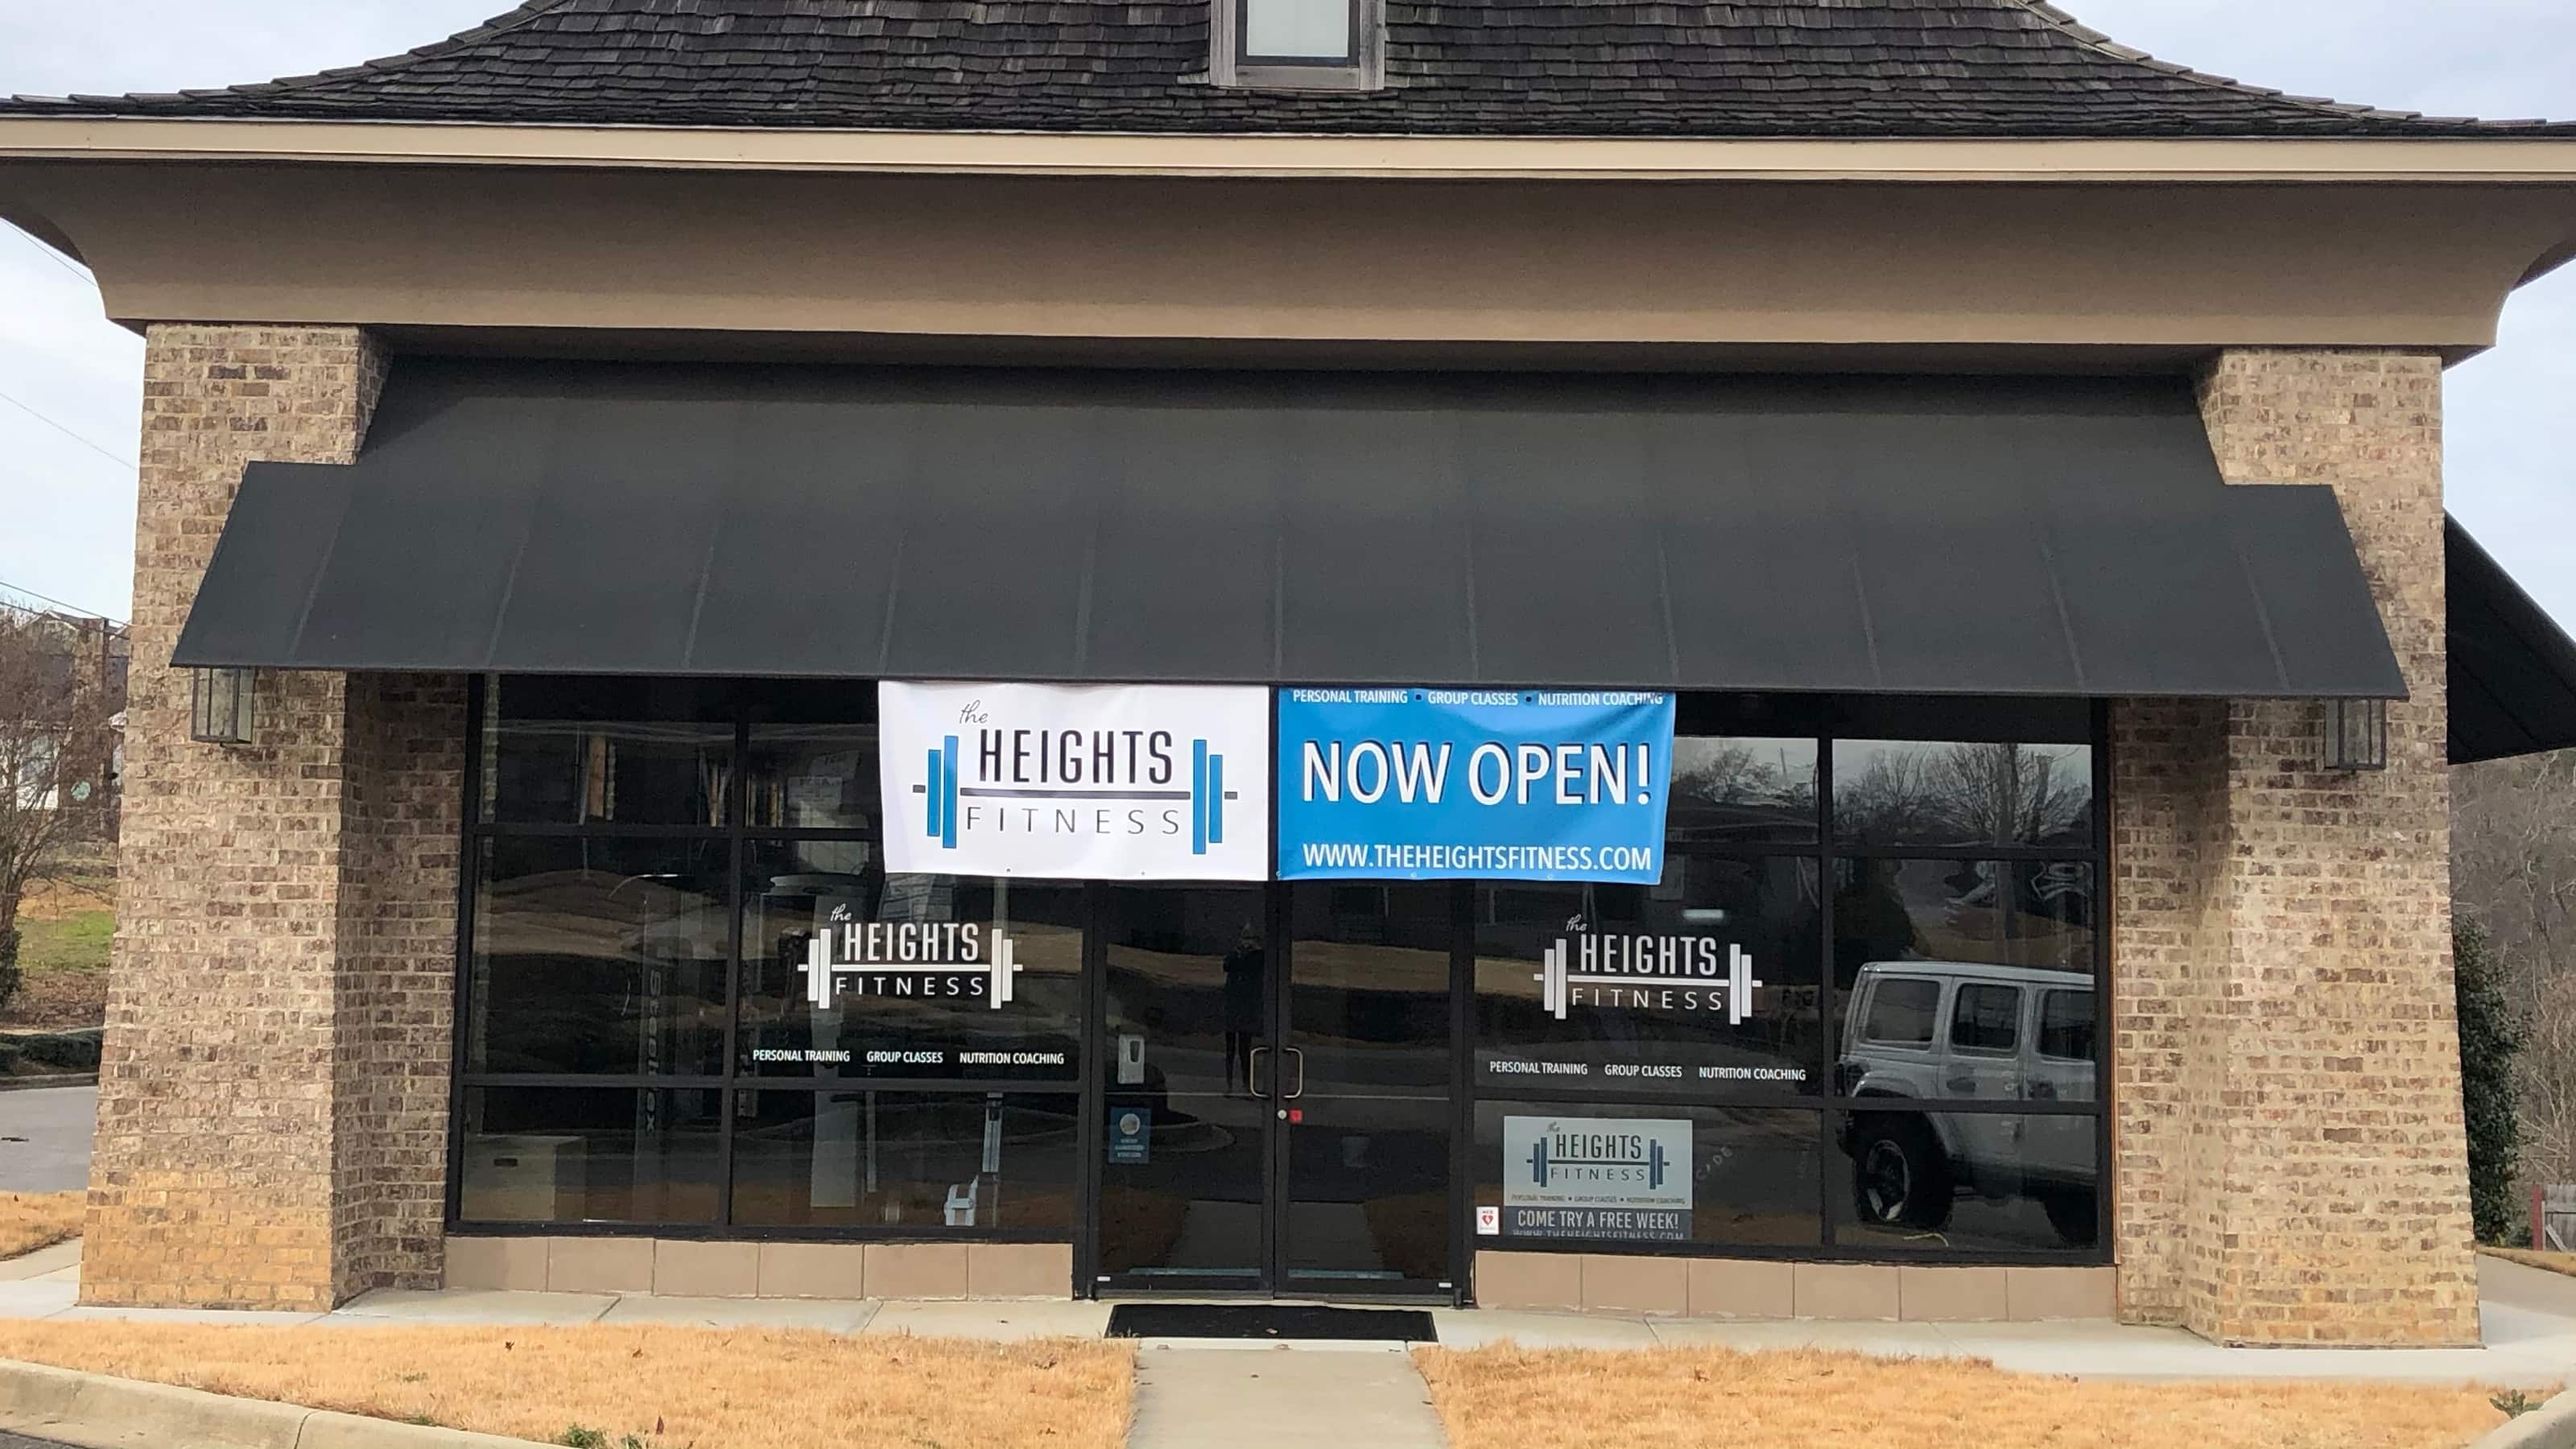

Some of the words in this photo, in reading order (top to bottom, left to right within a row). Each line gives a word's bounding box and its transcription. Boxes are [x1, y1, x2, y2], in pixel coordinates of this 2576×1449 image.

[1293, 688, 1352, 704] PERSONAL
[1353, 689, 1408, 704] TRAINING
[1426, 690, 1469, 705] GROUP
[1471, 691, 1519, 706] CLASSES
[1538, 692, 1600, 706] NUTRITION
[1602, 691, 1663, 706] COACHING
[959, 699, 989, 724] the
[980, 729, 1172, 785] HEIGHTS
[1303, 741, 1451, 803] NOW
[1468, 744, 1649, 806] OPEN!
[967, 806, 1179, 835] FITNESS
[1302, 843, 1652, 871] WWW.THEHEIGHTSFITNESS.COM
[830, 903, 852, 922] the
[1566, 914, 1587, 931] the
[844, 923, 979, 961] HEIGHTS
[1579, 934, 1716, 976] HEIGHTS
[836, 976, 983, 996] FITNESS
[1572, 988, 1722, 1010] FITNESS
[753, 1049, 803, 1062] PERSONAL
[804, 1050, 850, 1062] TRAINING
[866, 1051, 902, 1063] GROUP
[902, 1051, 943, 1063] CLASSES
[960, 1052, 1011, 1064] NUTRITION
[1013, 1052, 1064, 1064] COACHING
[1489, 1060, 1540, 1074] PERSONAL
[1541, 1062, 1588, 1075] TRAINING
[1604, 1063, 1640, 1076] GROUP
[1641, 1065, 1682, 1078] CLASSES
[1699, 1067, 1752, 1080] NUTRITION
[1753, 1067, 1806, 1081] COACHING
[1555, 1133, 1641, 1160] HEIGHTS
[1550, 1167, 1645, 1182] FITNESS
[1517, 1209, 1555, 1227] COME
[1558, 1210, 1583, 1228] TRY
[1586, 1211, 1595, 1228] A
[1600, 1212, 1632, 1229] FREE
[1636, 1212, 1678, 1229] WEEK!
